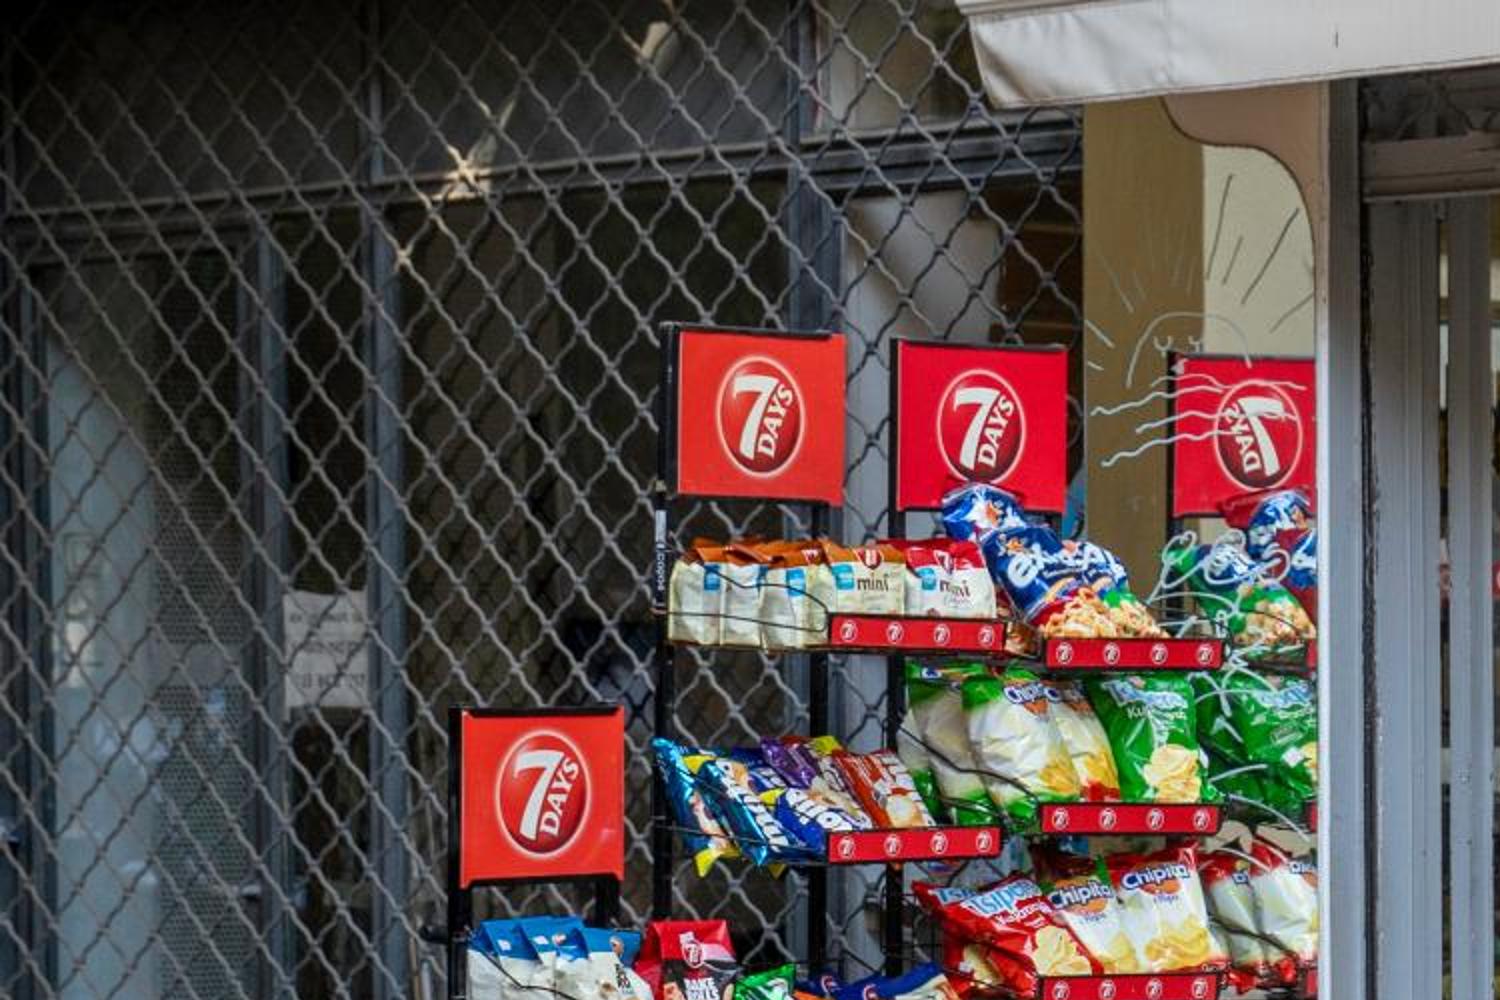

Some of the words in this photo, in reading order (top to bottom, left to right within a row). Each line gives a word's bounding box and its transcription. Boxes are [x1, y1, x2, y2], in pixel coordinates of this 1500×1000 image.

[733, 375, 779, 460] 7
[758, 384, 793, 458] DAYS
[953, 387, 1001, 470] 7
[977, 395, 1014, 467] DAYS
[857, 571, 889, 592] mini
[513, 750, 564, 840] 7
[540, 758, 579, 838] DAYS
[1048, 883, 1114, 909] Chipita
[1121, 863, 1190, 890] Chipita
